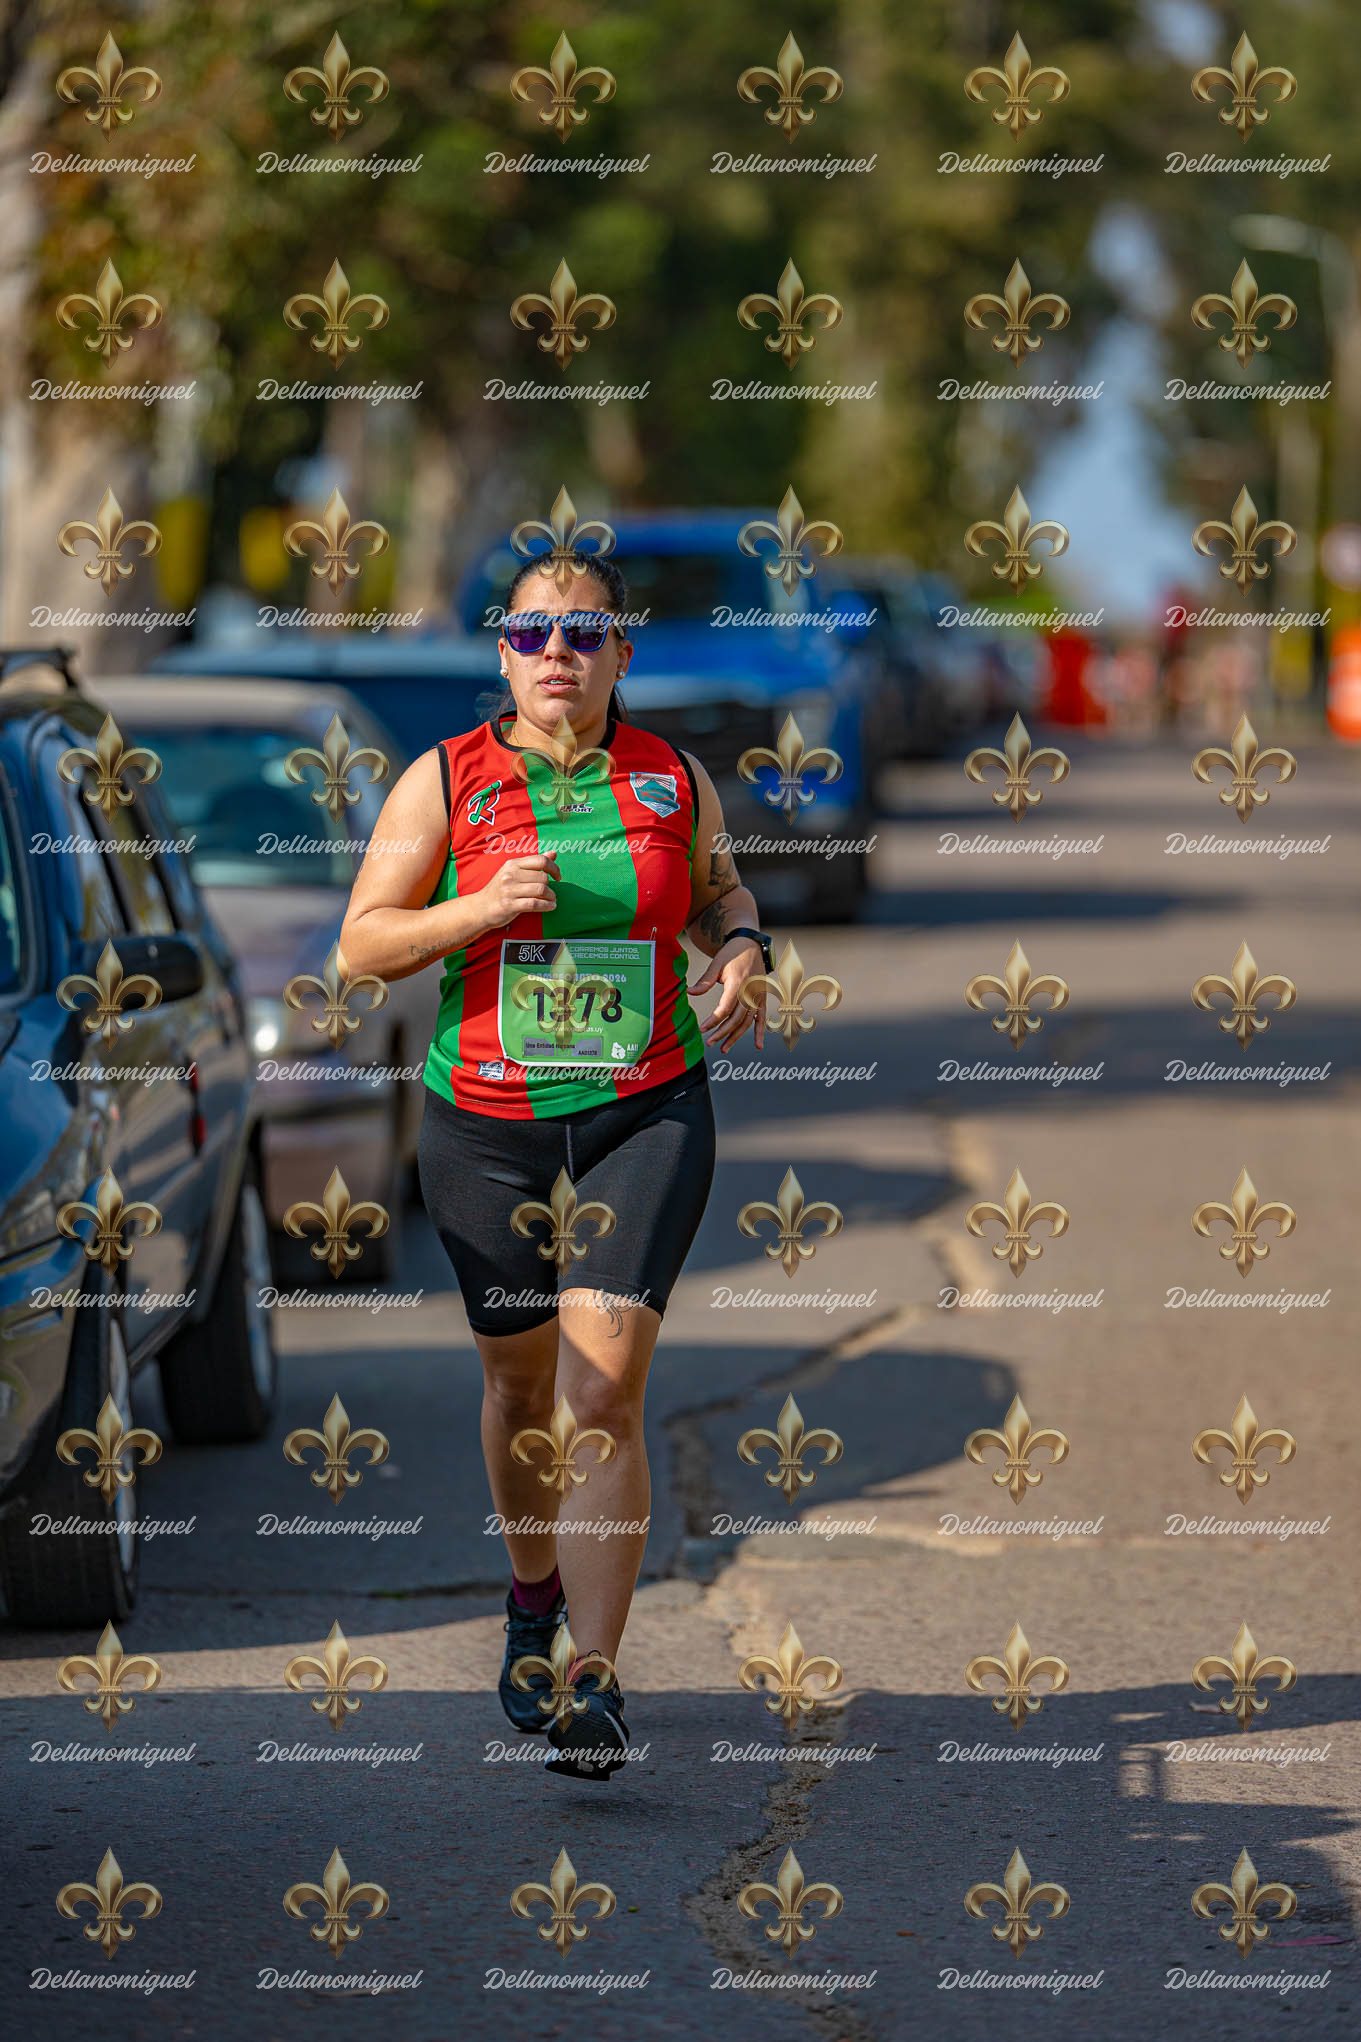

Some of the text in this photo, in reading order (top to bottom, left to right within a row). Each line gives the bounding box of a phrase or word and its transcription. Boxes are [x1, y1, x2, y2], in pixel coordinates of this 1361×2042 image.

[518, 944, 546, 962] 5K
[602, 974, 627, 983] 2026
[533, 987, 621, 1023] 1378
